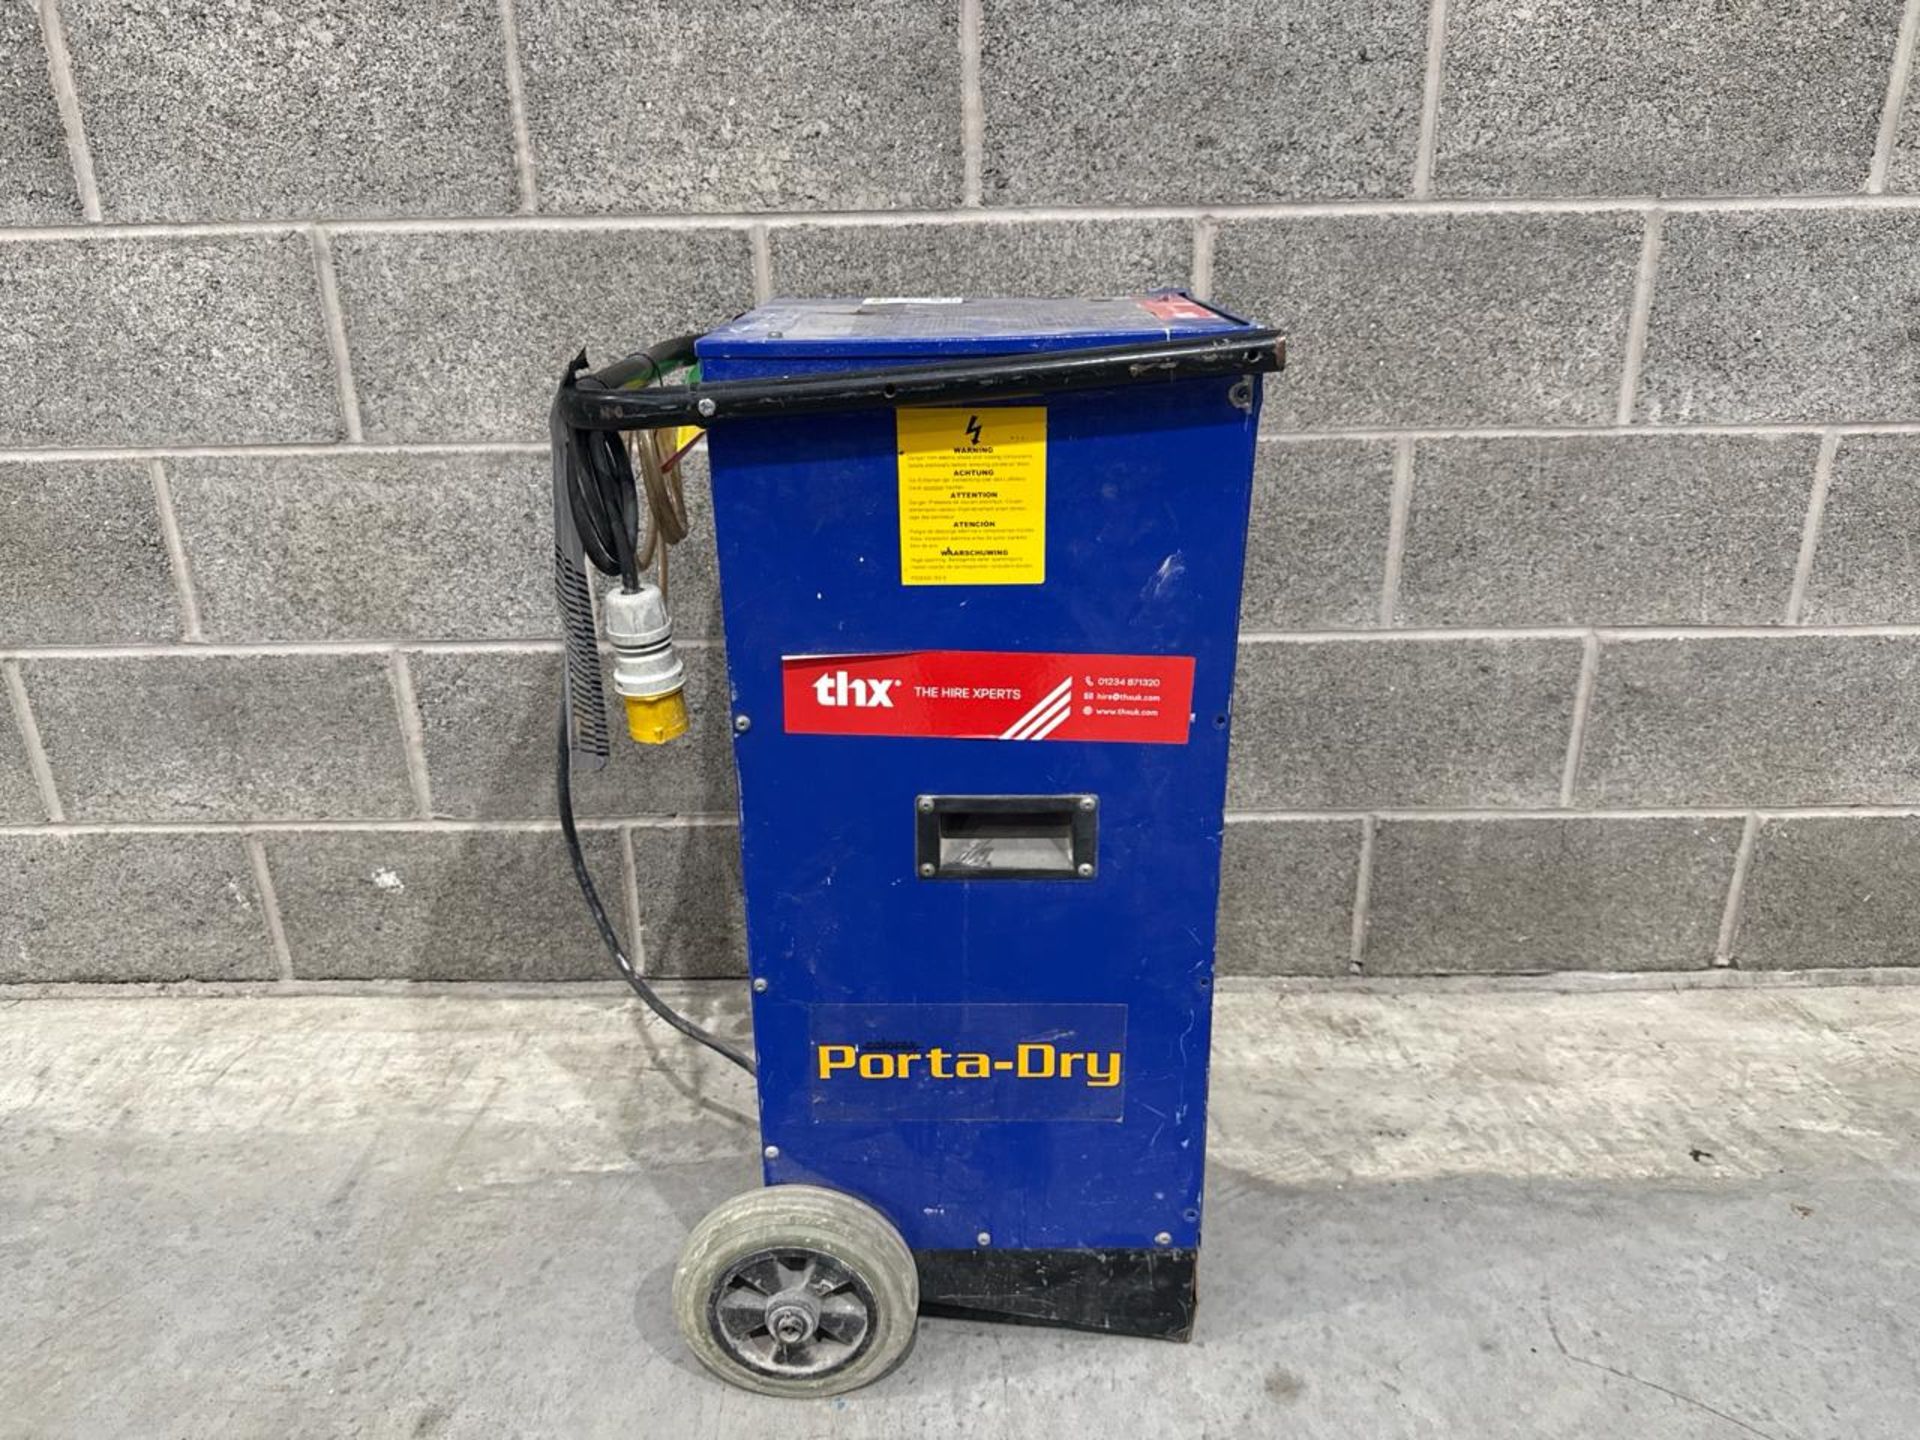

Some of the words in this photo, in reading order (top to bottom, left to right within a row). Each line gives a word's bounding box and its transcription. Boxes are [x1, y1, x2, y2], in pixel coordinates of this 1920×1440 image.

[953, 446, 994, 454] WARNING
[953, 469, 995, 477] ACHTUNG
[950, 491, 998, 499] ATTENTION
[1097, 677, 1126, 687] 01234
[1127, 678, 1161, 688] 871320
[812, 670, 895, 708] thx
[914, 686, 939, 698] THE
[941, 687, 970, 699] HIRE
[972, 687, 1021, 701] XPERTS
[817, 1043, 1122, 1088] Porta-Dry
